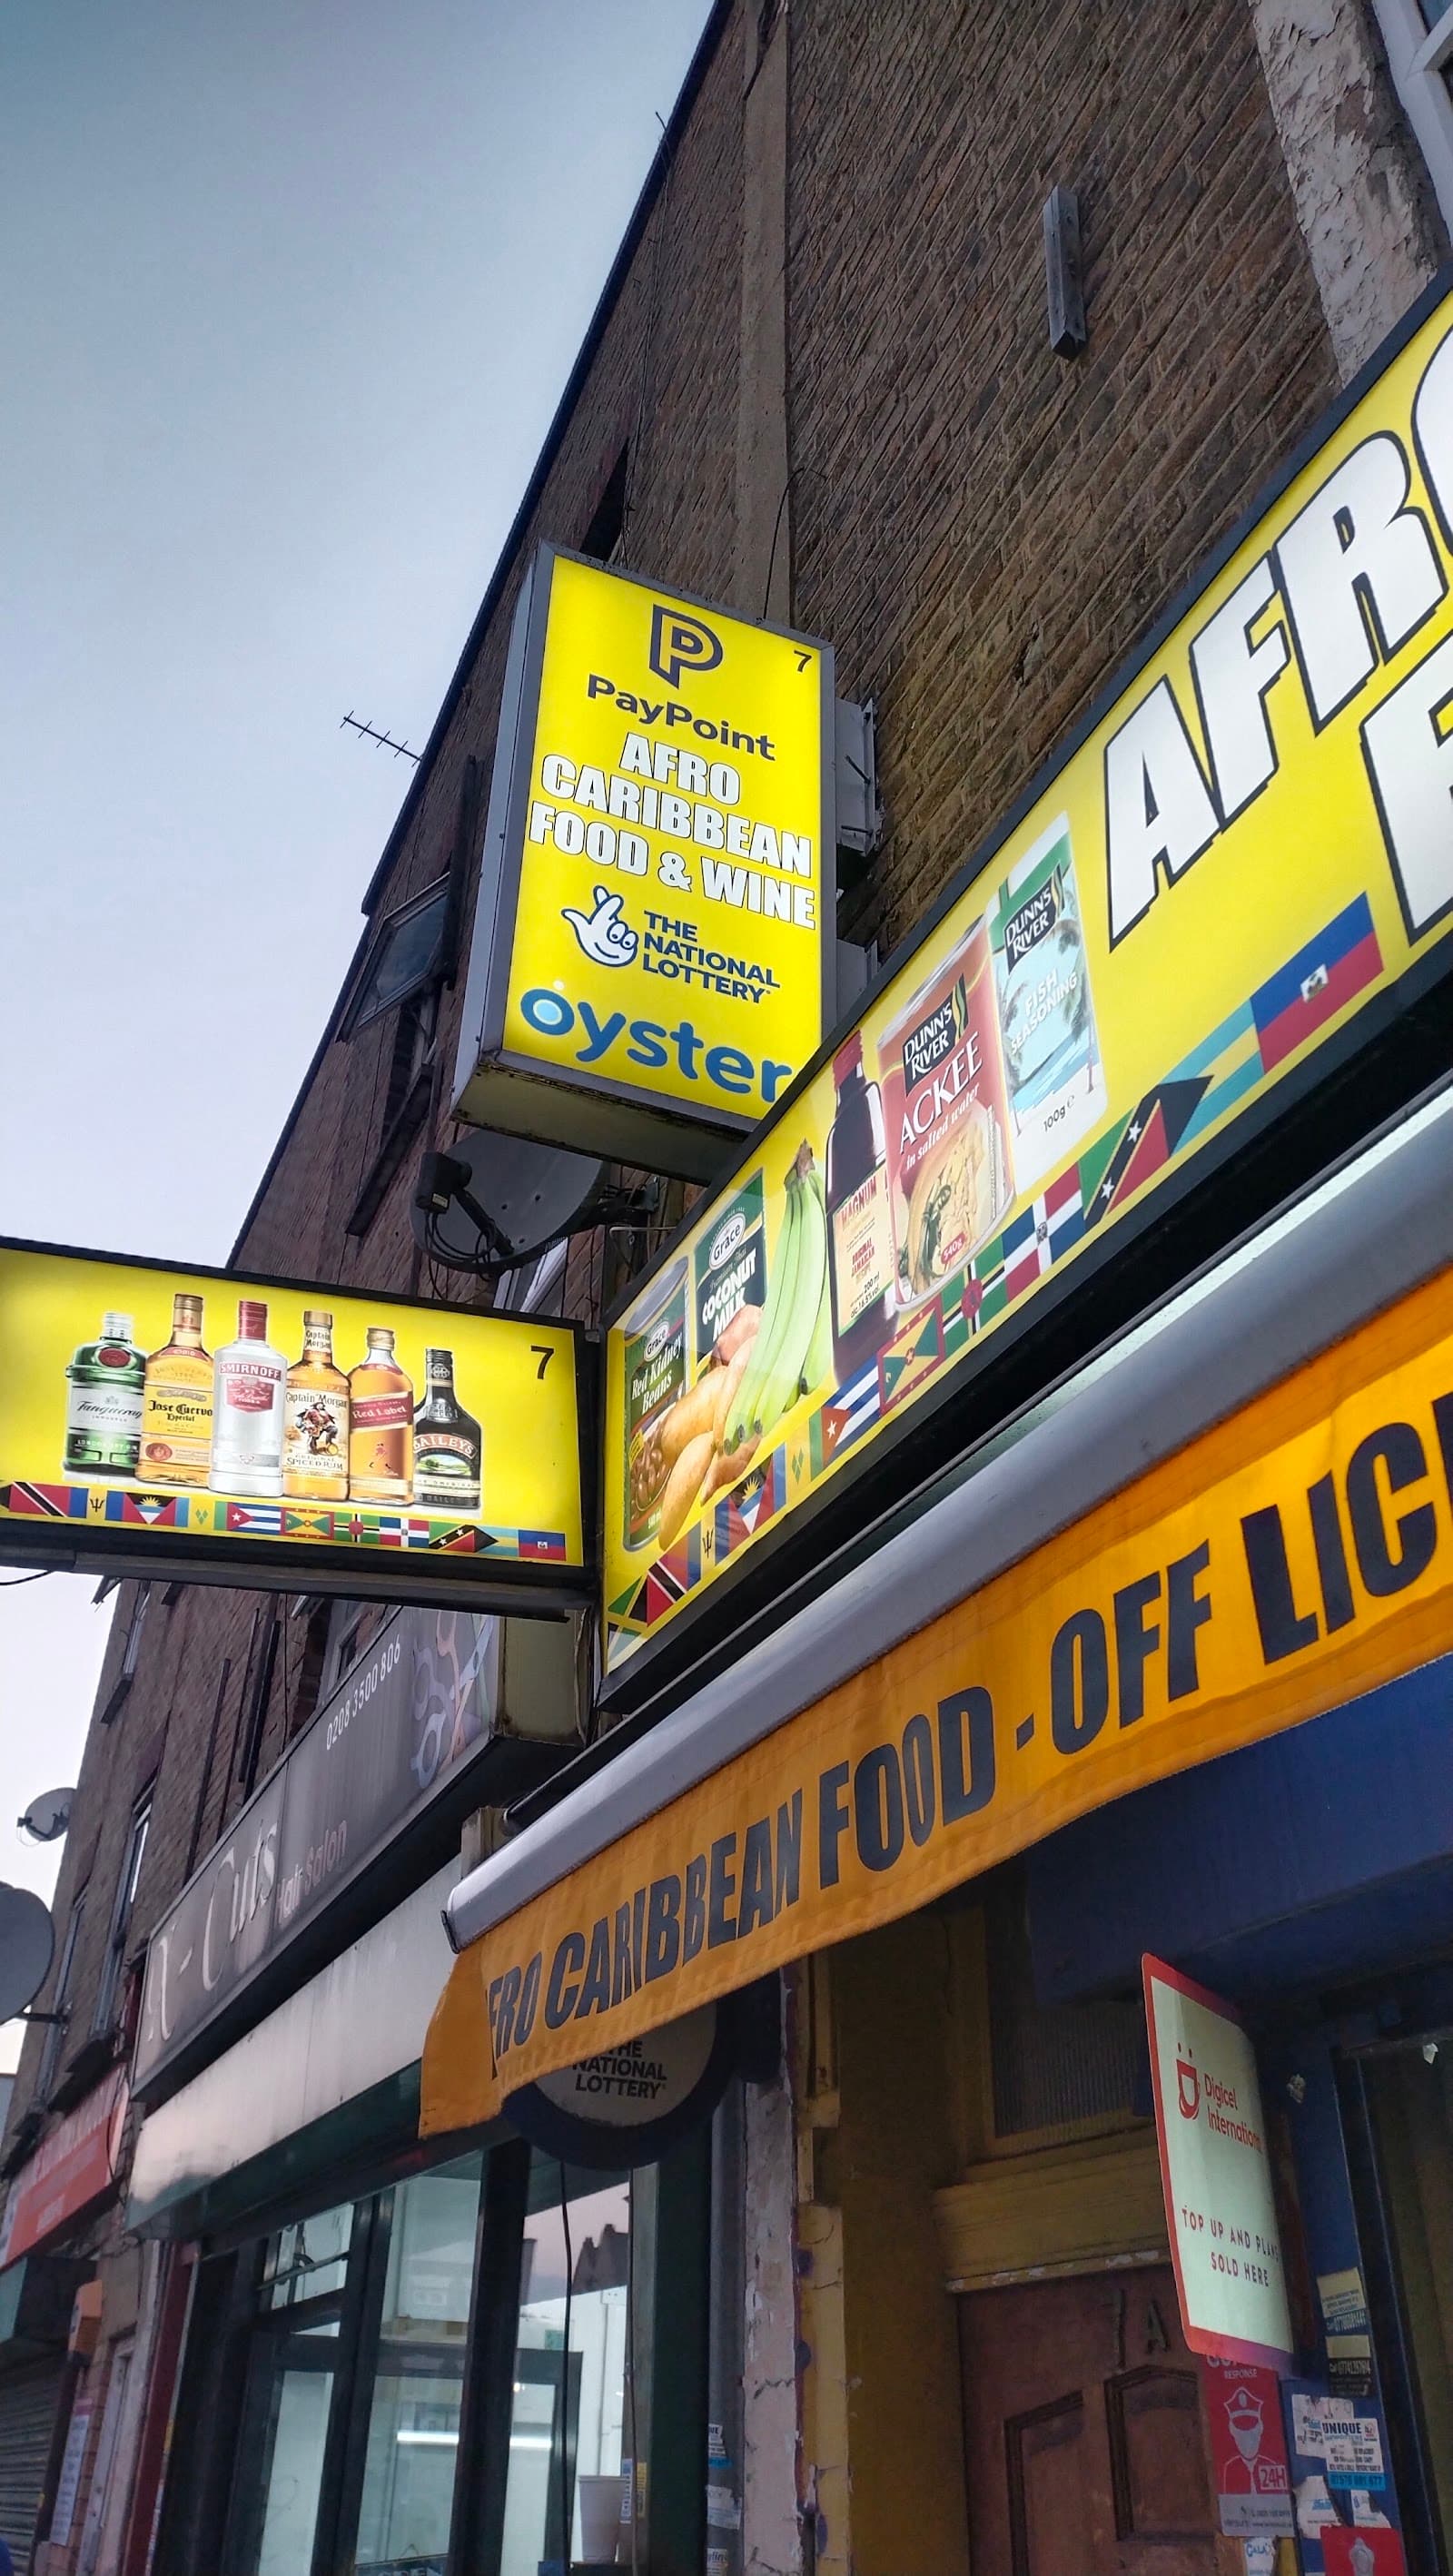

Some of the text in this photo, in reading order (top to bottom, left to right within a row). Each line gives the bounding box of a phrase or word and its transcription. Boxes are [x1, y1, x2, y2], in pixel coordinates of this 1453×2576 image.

[1104, 320, 1453, 952] AFR
[794, 649, 813, 674] 7
[588, 674, 776, 761] PayPoint
[620, 733, 740, 805] AFRO
[541, 755, 811, 879] CARIBBEAN
[529, 802, 815, 930] FOOD & WINE
[644, 911, 697, 943] THE
[1006, 885, 1052, 942] DUNN'S
[1013, 912, 1049, 960] RIVER
[642, 955, 769, 1004] LOTTERY
[643, 933, 780, 989] NATIONAL
[1011, 972, 1078, 1056] SEASONING
[1025, 967, 1059, 1017] FISH
[520, 988, 796, 1103] oyster
[904, 1002, 953, 1065] DUNN'S
[912, 1031, 949, 1080] RIVER
[900, 1031, 983, 1154] ACKEE
[917, 1116, 948, 1160] salted
[952, 1083, 979, 1126] water
[842, 1176, 877, 1226] MAGNUM
[713, 1225, 741, 1260] Grace
[702, 1248, 756, 1325] COCONUT
[305, 1329, 331, 1342] Captain
[713, 1287, 746, 1342] MILK
[530, 1346, 555, 1379] 7
[647, 1329, 667, 1354] Grace
[221, 1365, 280, 1378] SMIRNOFF
[632, 1333, 683, 1400] Red Kidney
[77, 1400, 143, 1419] Tanqueray
[286, 1391, 315, 1404] Captain
[317, 1394, 348, 1408] Morgan
[352, 1405, 407, 1418] Red Label
[642, 1369, 673, 1416] Beans
[414, 1436, 475, 1456] BAILEYS
[327, 1700, 351, 1751] 0208
[380, 1633, 400, 1682] 806
[486, 1951, 542, 2079] FRO
[545, 1788, 803, 2030] CARIBBEAN
[818, 1686, 995, 1890] FOOD
[1051, 1538, 1212, 1755] OFF
[572, 2057, 667, 2081] NATIONAL
[576, 2074, 662, 2100] LOTTERY
[1204, 2073, 1238, 2110] Digicel
[1181, 2207, 1204, 2232] TOP
[1211, 2218, 1223, 2239] UP
[1231, 2226, 1250, 2249] AND
[1211, 2252, 1269, 2286] SOLD HERE
[1322, 2423, 1362, 2434] UNIQUE
[1260, 2468, 1286, 2489] 24H
